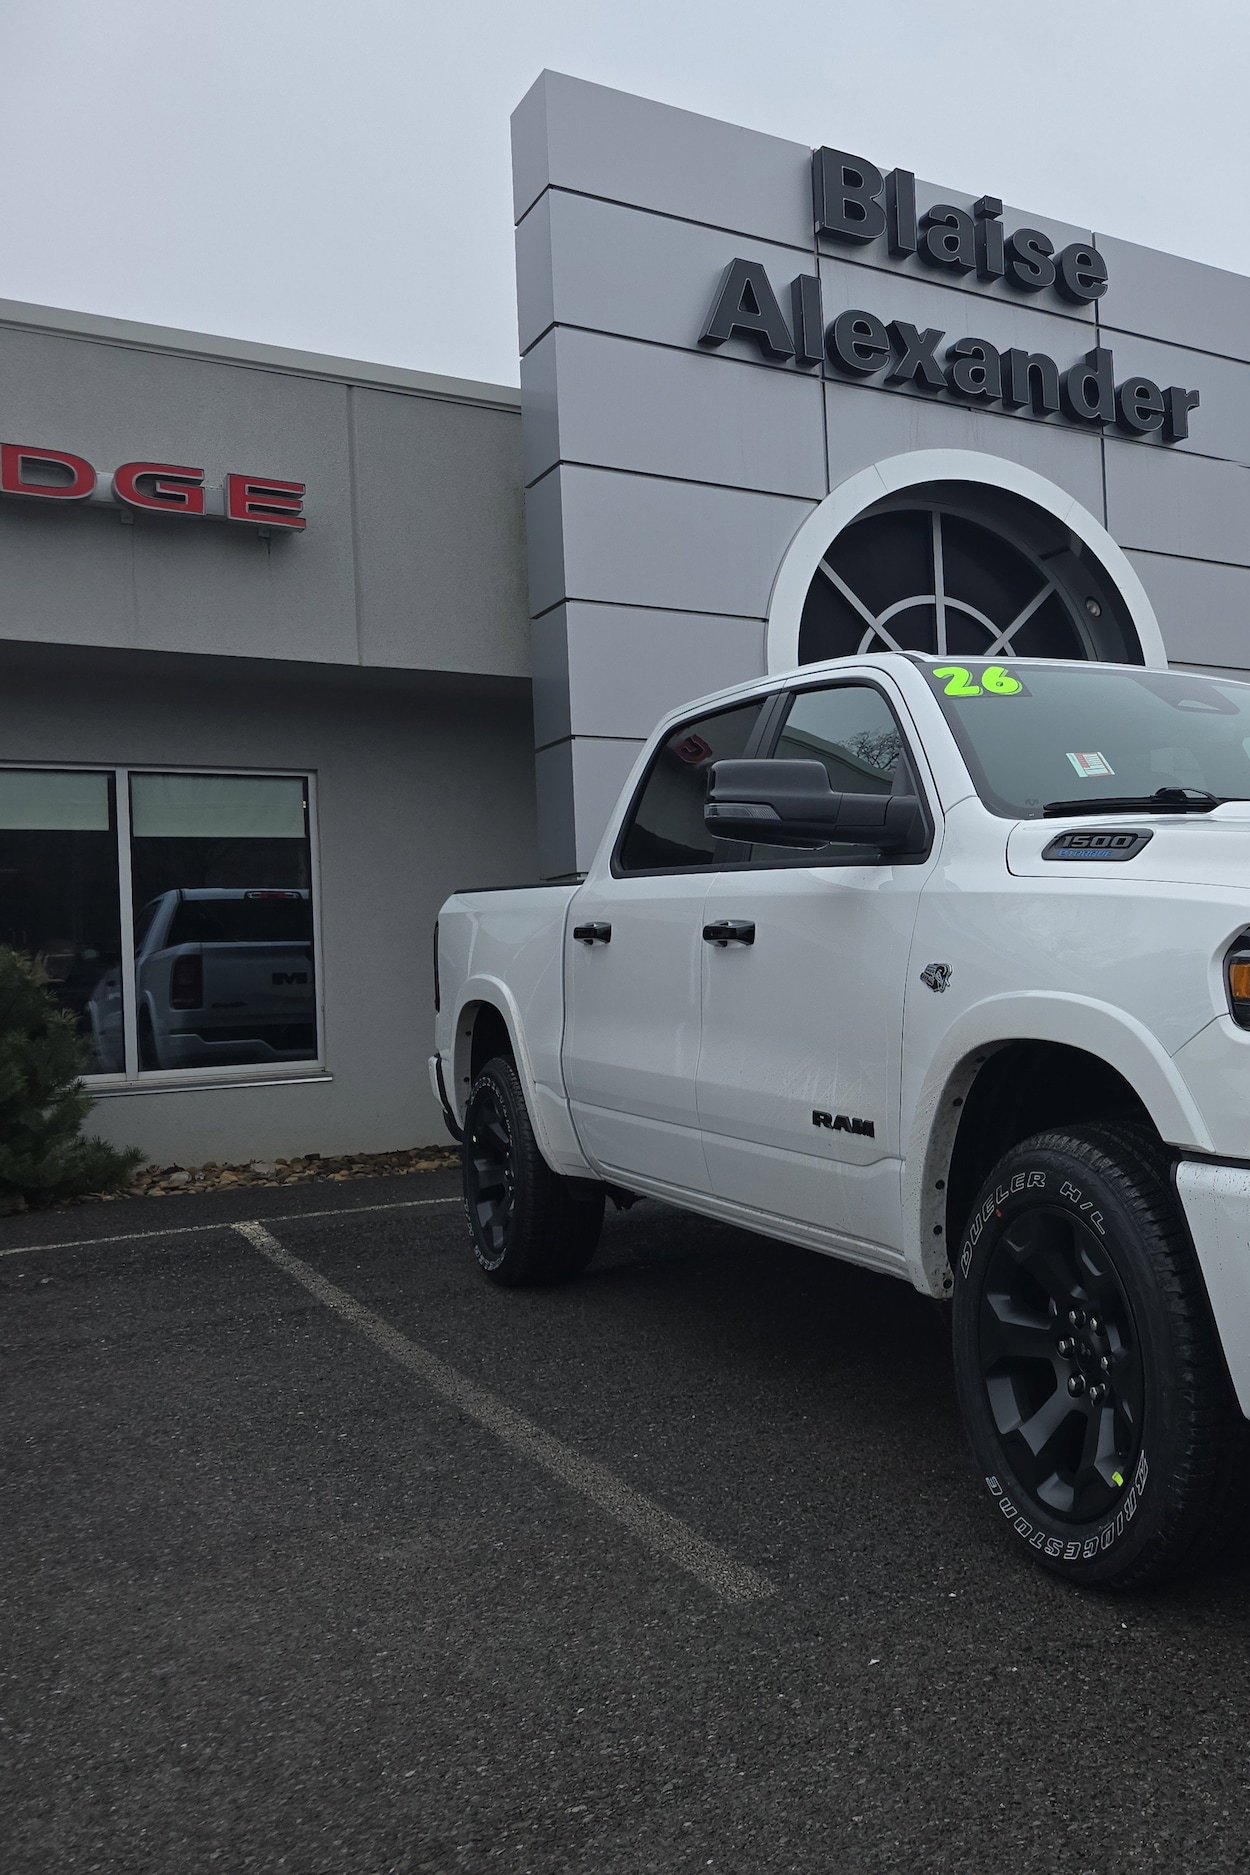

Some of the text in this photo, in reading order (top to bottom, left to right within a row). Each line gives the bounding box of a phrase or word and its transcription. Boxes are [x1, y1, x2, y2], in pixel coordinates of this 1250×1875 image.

[813, 145, 1108, 305] Blaise
[698, 257, 1200, 443] Alexander
[932, 666, 1023, 696] 26
[1062, 835, 1133, 848] 1500
[812, 1110, 875, 1138] RAM
[961, 1171, 1105, 1279] DUELER H/L
[985, 1449, 1149, 1560] BRIDGESTONE
